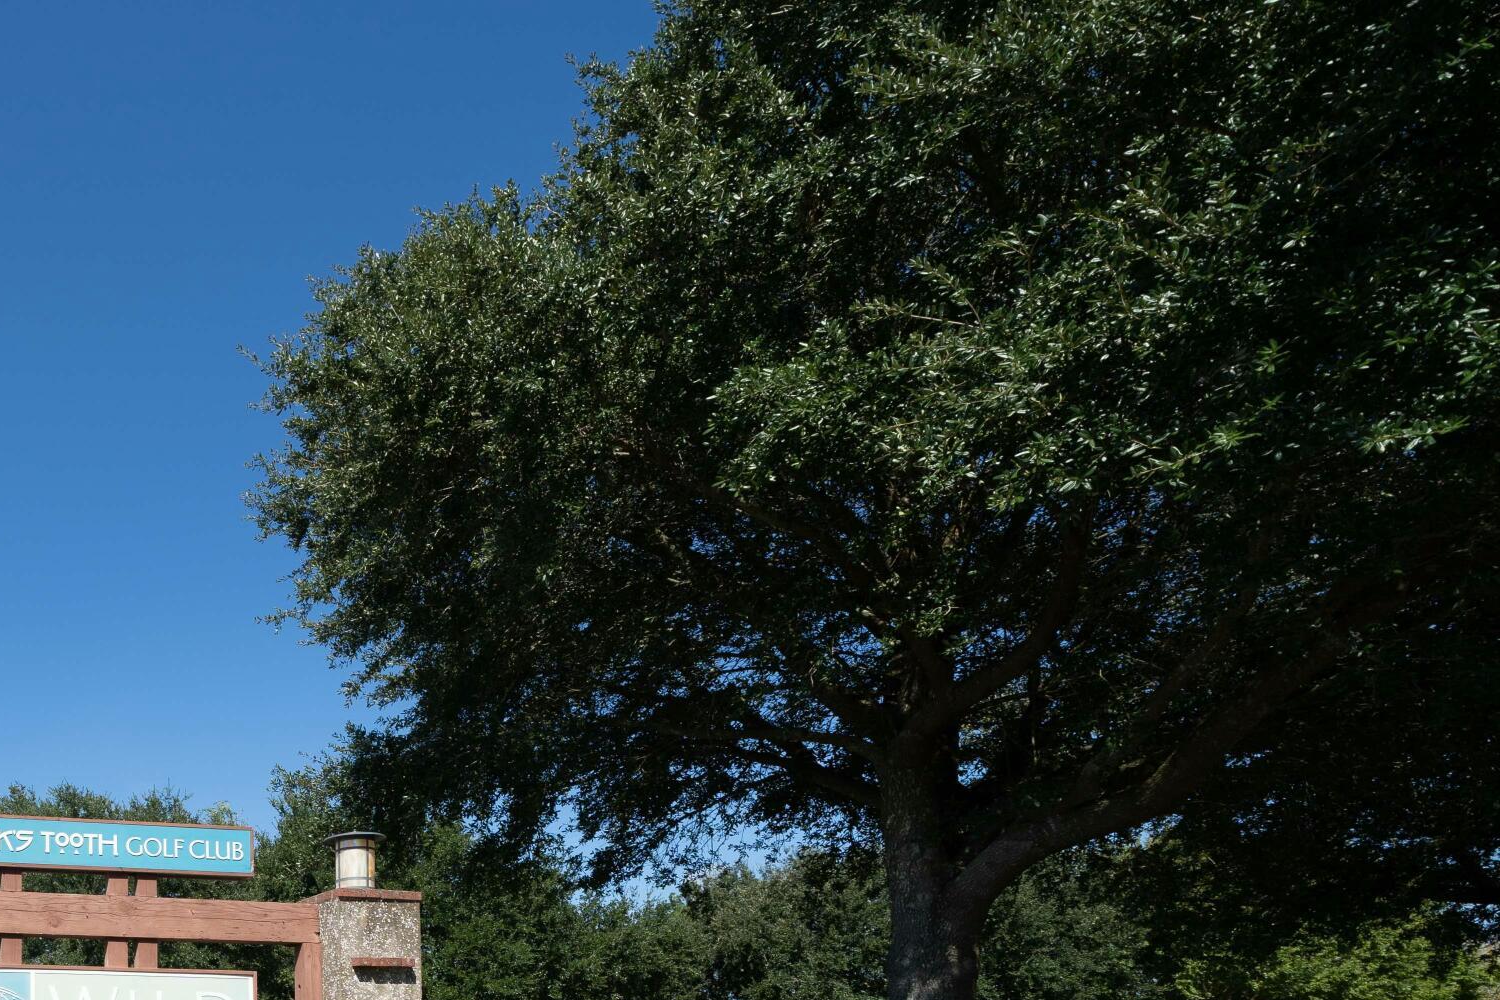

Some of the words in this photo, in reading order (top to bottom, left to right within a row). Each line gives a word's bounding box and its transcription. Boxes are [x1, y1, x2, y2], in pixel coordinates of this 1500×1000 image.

[40, 831, 119, 857] TOOTH
[125, 836, 184, 858] GOLF
[189, 839, 245, 861] CLUB
